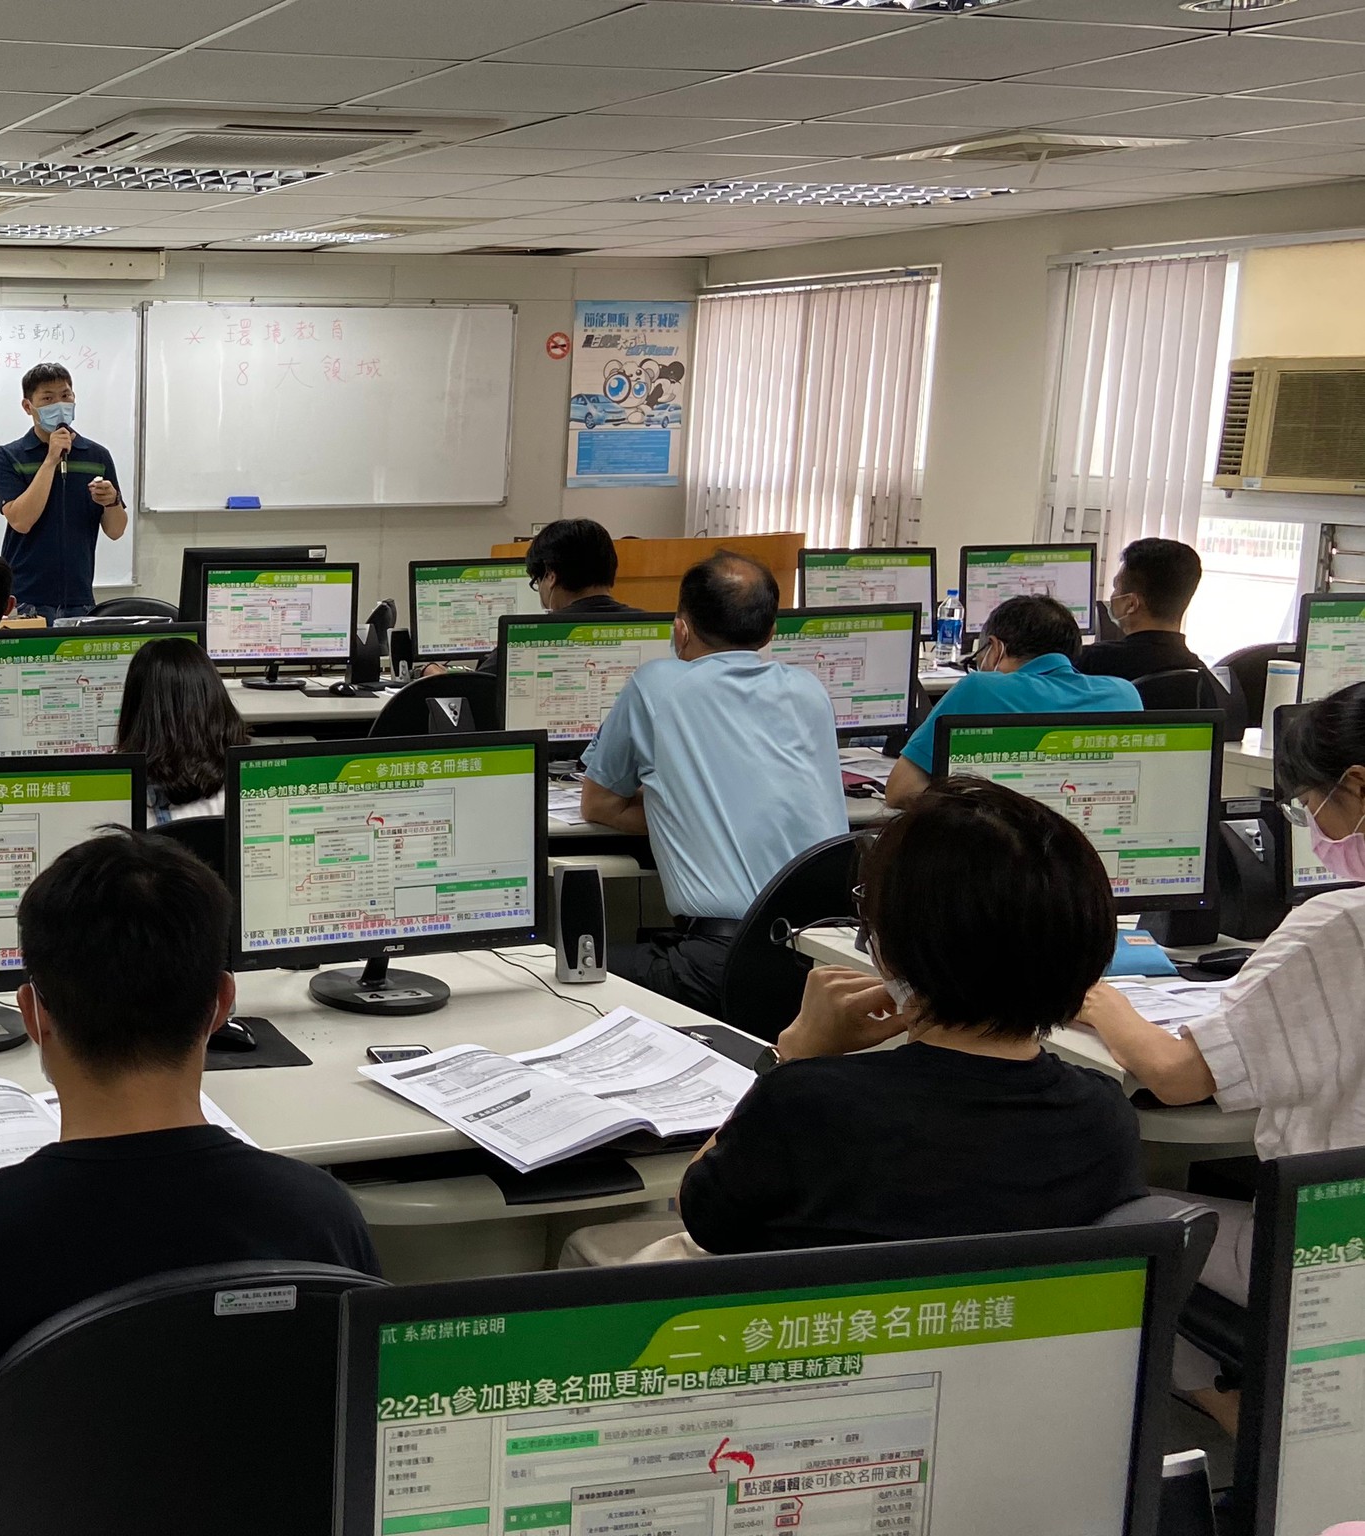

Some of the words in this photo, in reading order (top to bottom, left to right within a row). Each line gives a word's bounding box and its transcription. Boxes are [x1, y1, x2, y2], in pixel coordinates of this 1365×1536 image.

[224, 318, 344, 347] 環境教育
[348, 757, 483, 780] 二、參加對象名冊維護
[266, 781, 348, 798] 參加對象名冊更新
[403, 1317, 507, 1343] 系統操作說明
[668, 1295, 1016, 1360] 二、參加對象名冊維護
[451, 1366, 666, 1415] 參加對象名冊更新
[708, 1353, 863, 1388] 線上單筆更新資料
[743, 1463, 912, 1498] 點選編輯後可修改名冊資料
